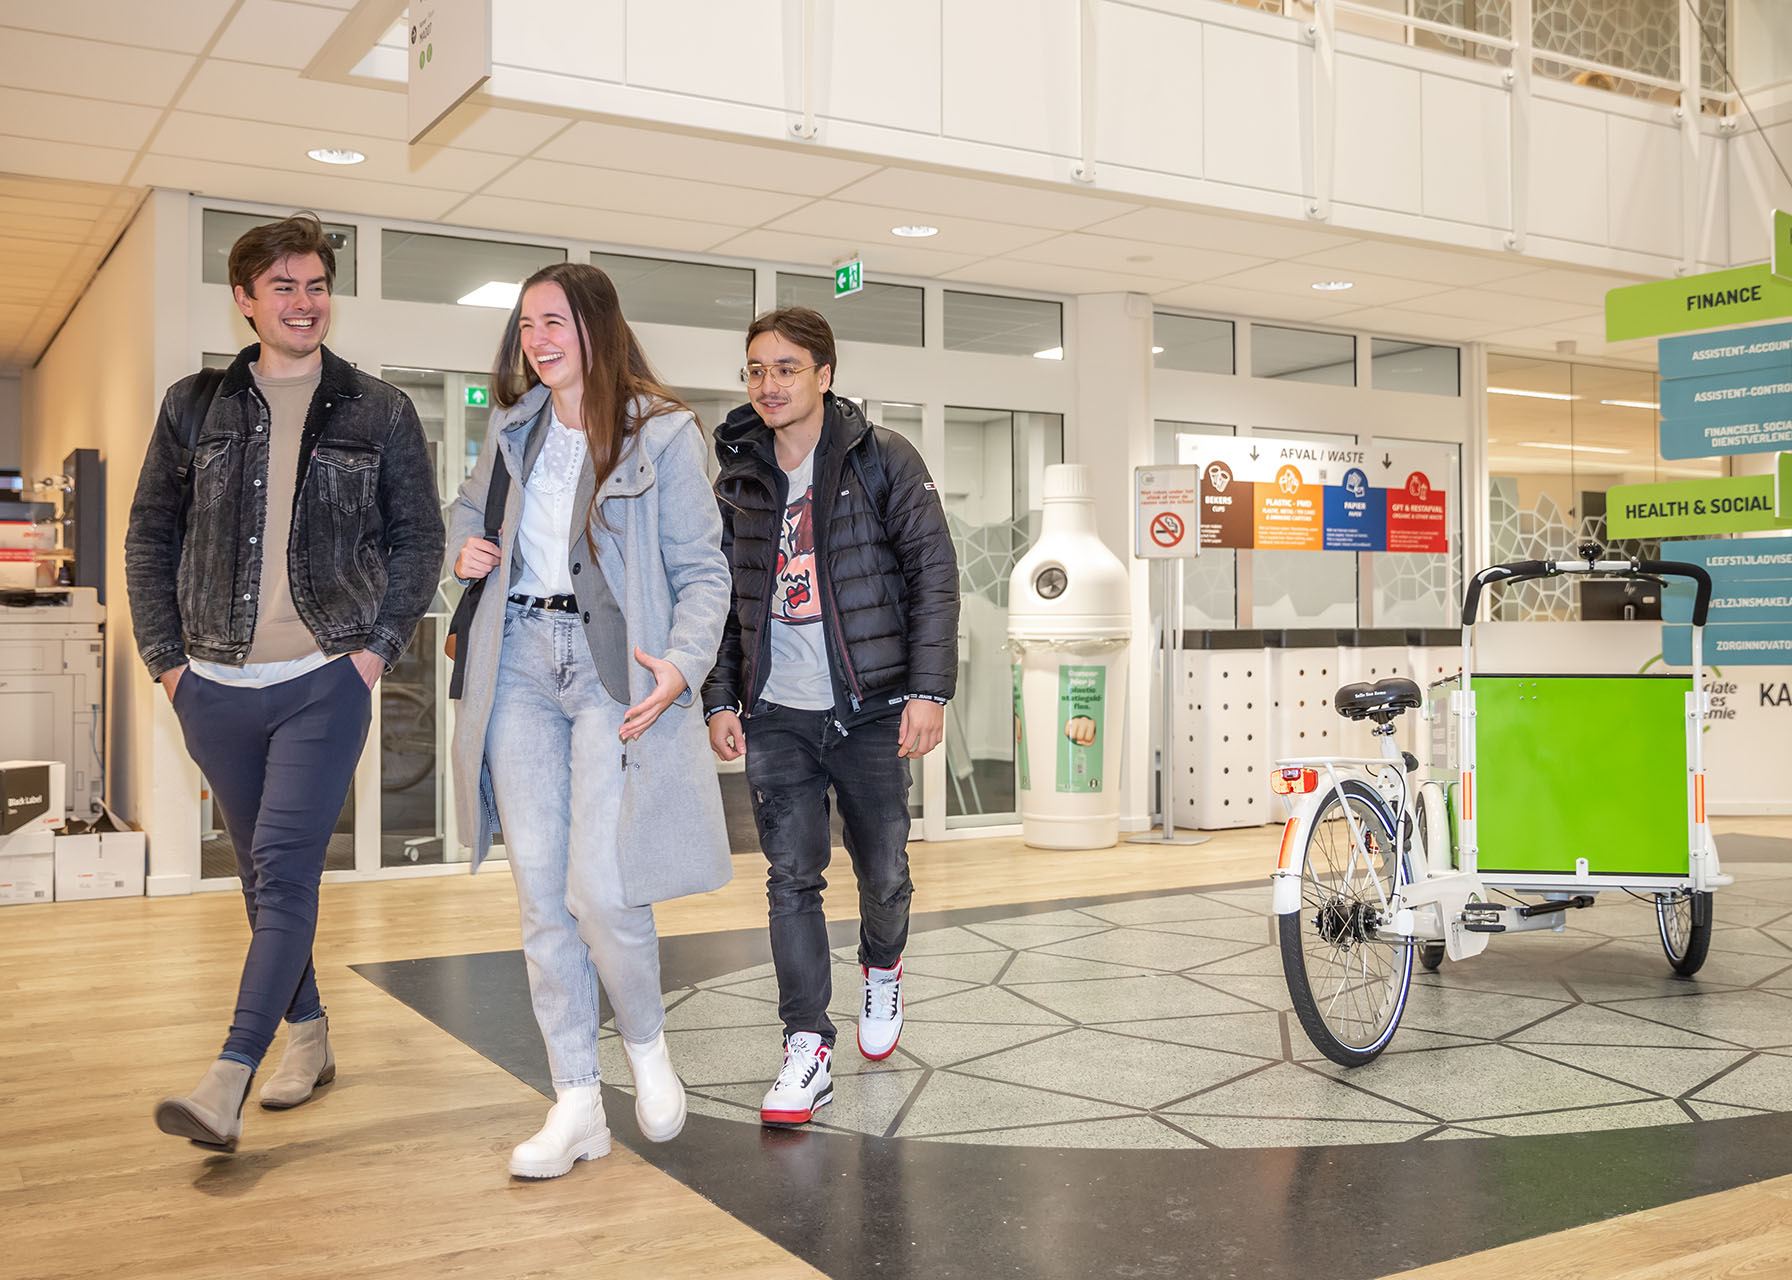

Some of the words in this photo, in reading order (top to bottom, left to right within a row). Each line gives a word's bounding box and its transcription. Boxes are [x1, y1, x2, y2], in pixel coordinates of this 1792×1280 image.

[1687, 285, 1762, 311] FINANCE
[1704, 424, 1761, 438] FINANCIEEL
[1280, 448, 1317, 461] AFVAL
[1327, 450, 1364, 463] WASTE
[1205, 496, 1232, 505] BEKERS
[1265, 498, 1291, 507] PLASTIC
[1344, 502, 1366, 511] PAPIER
[1626, 501, 1689, 519] HEALTH
[1693, 499, 1706, 515] &
[1710, 495, 1773, 514] SOCIAL
[8, 797, 25, 807] Black
[26, 794, 43, 804] Label
